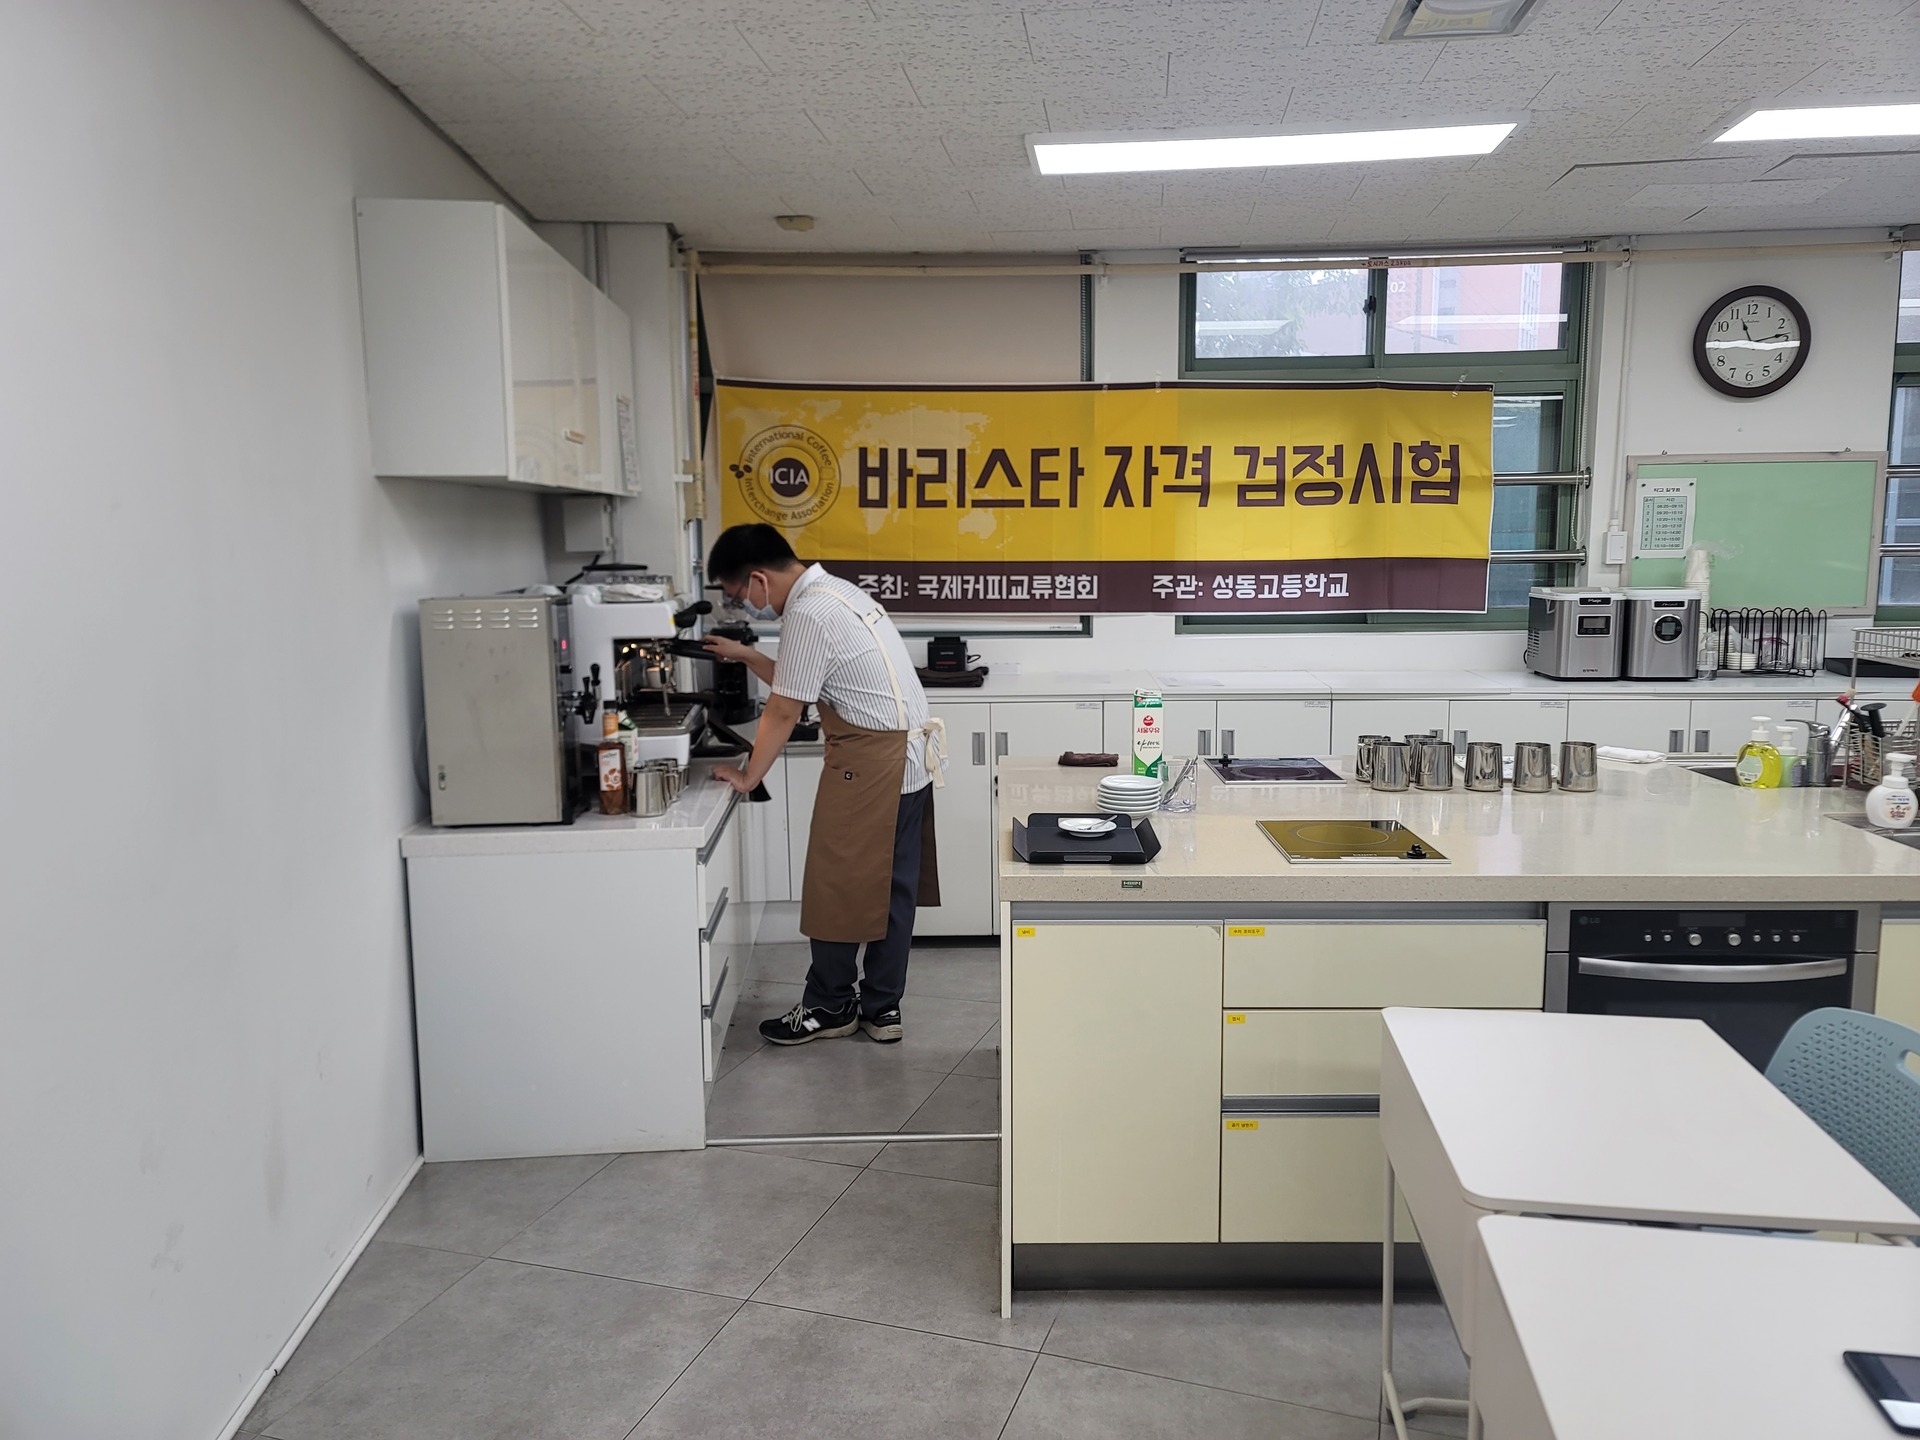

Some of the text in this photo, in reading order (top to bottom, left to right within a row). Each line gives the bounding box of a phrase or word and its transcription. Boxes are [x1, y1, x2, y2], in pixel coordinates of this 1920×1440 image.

[1730, 308, 1740, 320] 11
[1746, 303, 1758, 315] 12
[1716, 321, 1729, 332] 10
[1777, 318, 1786, 329] 2
[1716, 355, 1726, 367] 8
[1774, 352, 1783, 363] 4
[1728, 367, 1737, 378] 7
[1745, 370, 1753, 382] 6
[1762, 365, 1771, 377] 5
[745, 431, 832, 466] International Coffee
[768, 468, 809, 485] ICIA
[858, 440, 1461, 509] 바리스타 자격 검정시험
[745, 478, 834, 521] Interchange Association
[858, 574, 1099, 600] 주최: 국제커피교류협회
[1152, 573, 1350, 599] 주관: 성동고등학교
